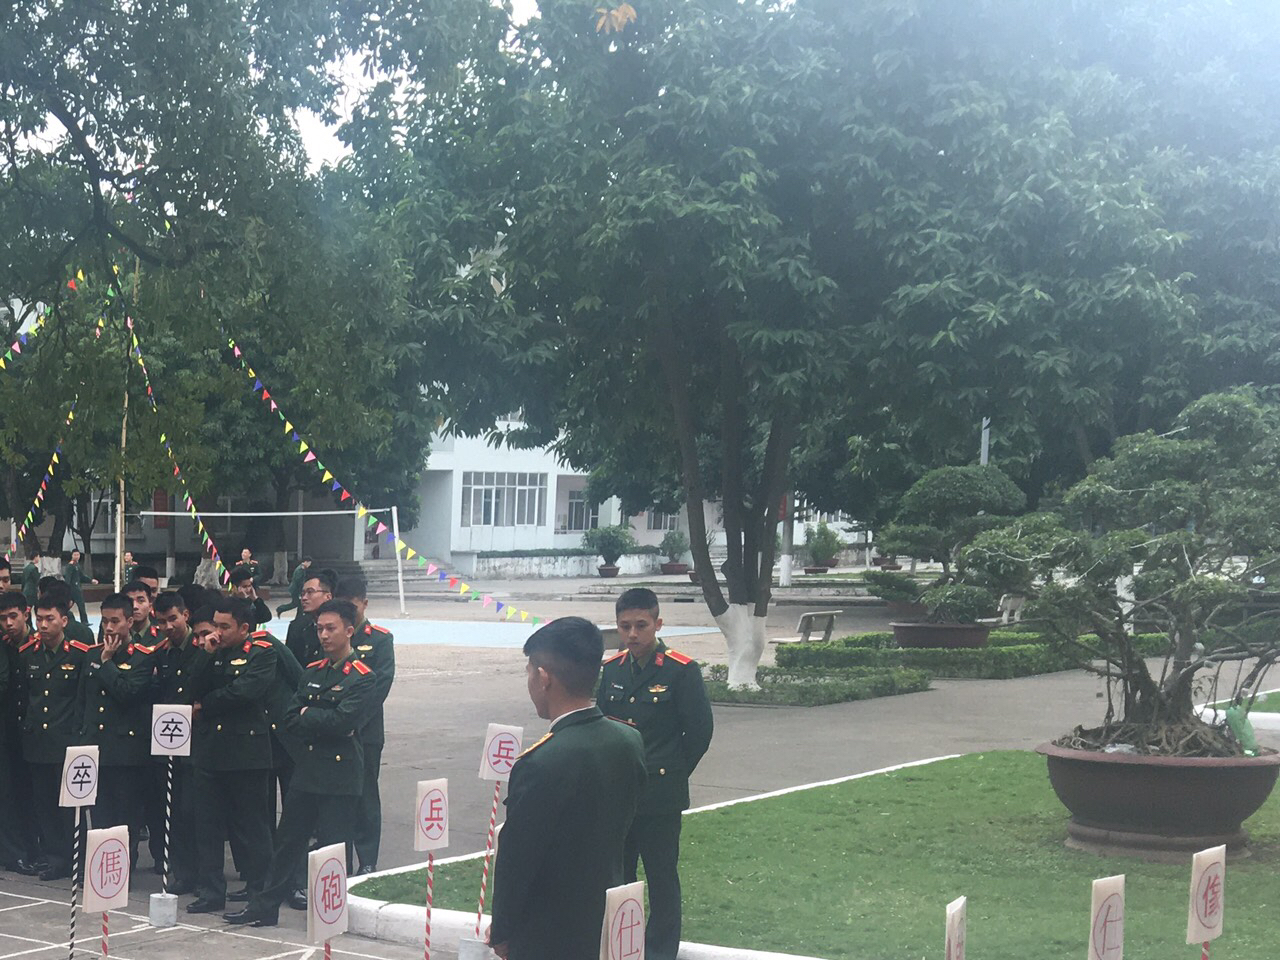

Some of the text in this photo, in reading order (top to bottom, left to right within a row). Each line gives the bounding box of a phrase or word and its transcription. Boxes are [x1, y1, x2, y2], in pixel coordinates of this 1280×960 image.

[160, 718, 183, 743] 卒
[492, 740, 515, 767] 兵
[72, 762, 91, 791] 卒
[425, 798, 443, 831] 兵
[321, 871, 342, 913] 砲
